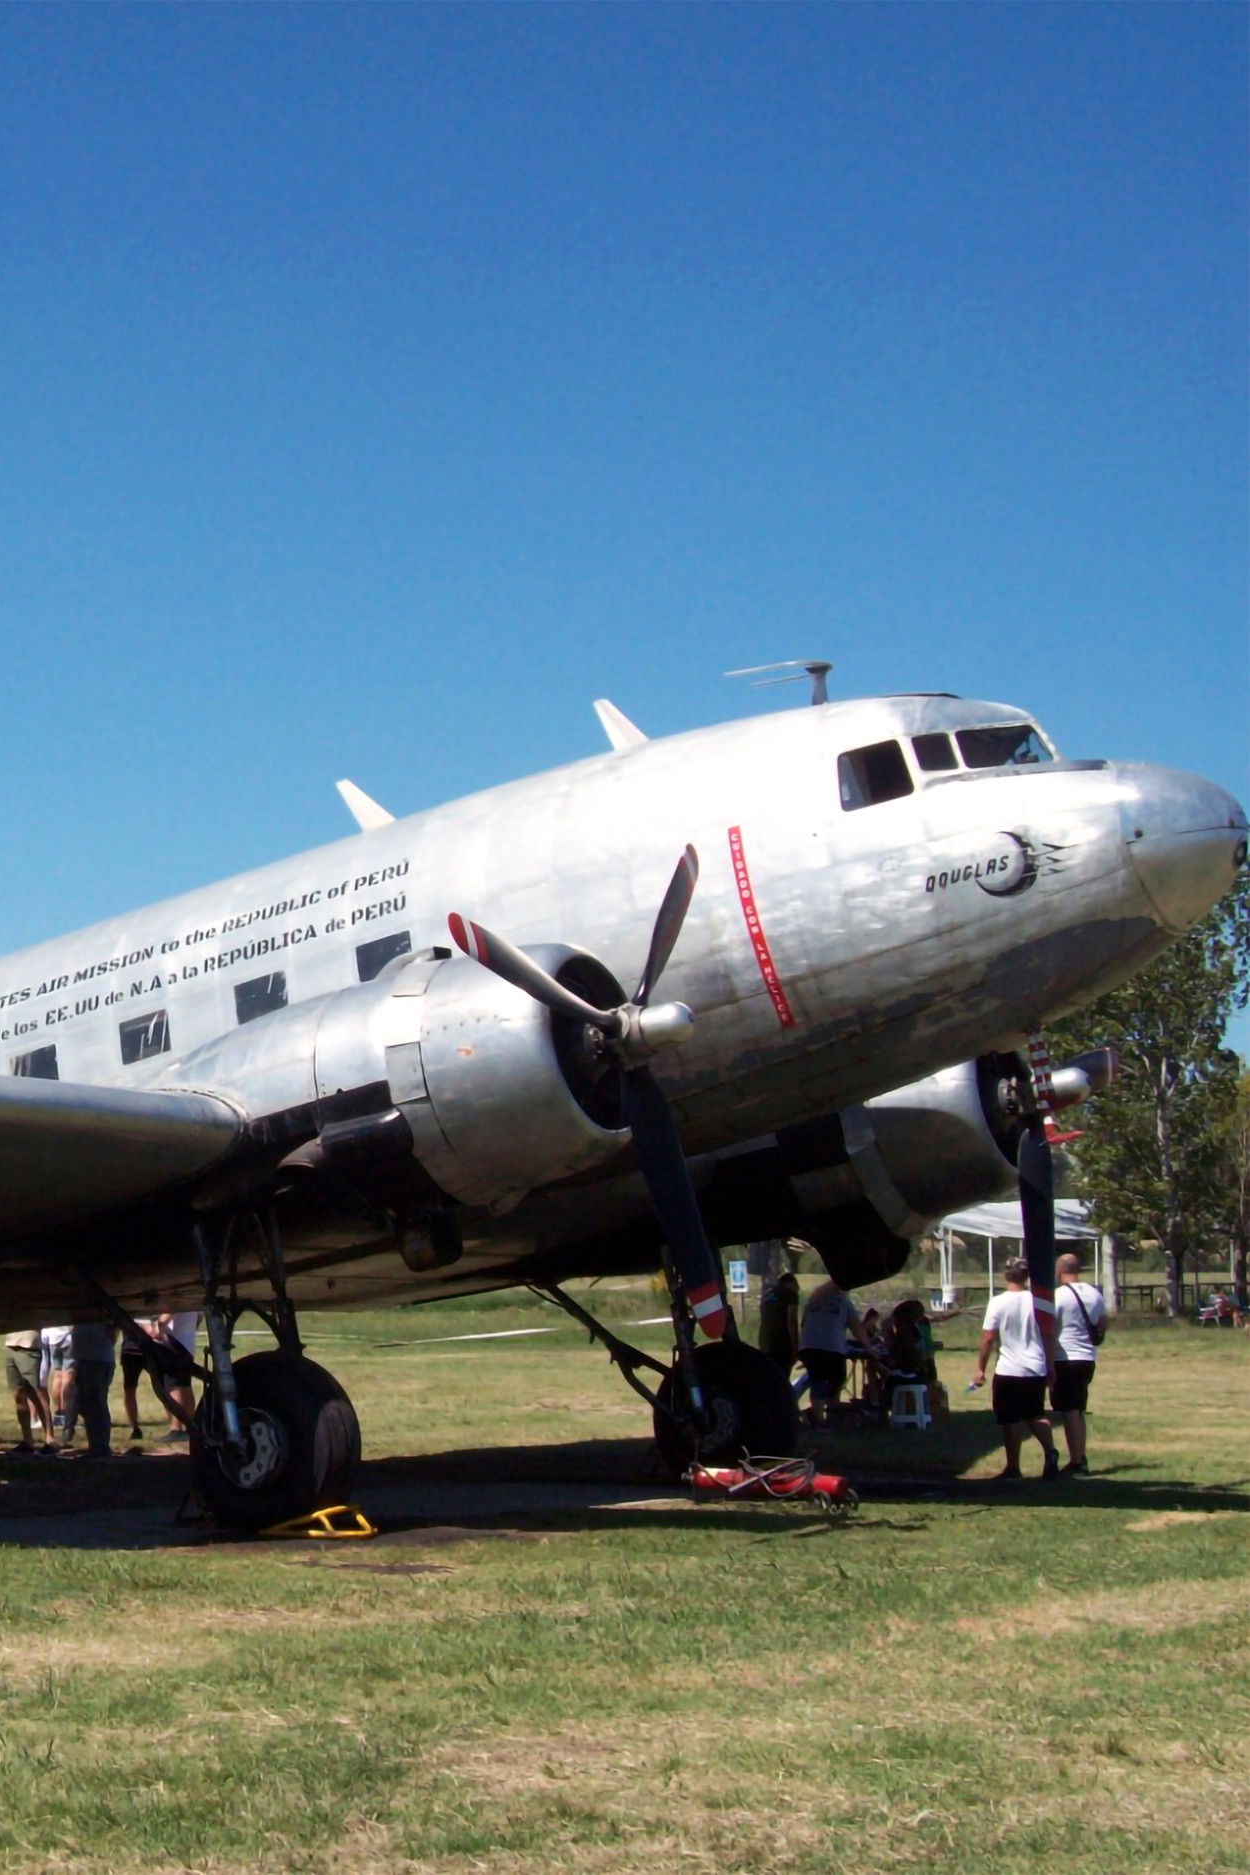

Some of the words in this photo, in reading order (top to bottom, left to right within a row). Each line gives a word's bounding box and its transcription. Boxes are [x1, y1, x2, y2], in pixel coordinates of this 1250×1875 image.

[36, 974, 70, 997] AIR
[73, 945, 154, 984] MISSION
[160, 939, 180, 955] to
[185, 927, 217, 946] the
[221, 889, 322, 935] REPUBLIC
[327, 880, 350, 900] of
[354, 858, 410, 892] PERÚ
[925, 855, 1009, 893] DOUGLAS
[14, 1020, 39, 1037] los
[45, 995, 100, 1026] EE.UU
[104, 991, 125, 1006] de
[130, 974, 163, 998] N.A
[167, 973, 178, 986] a
[182, 965, 199, 980] la
[204, 924, 318, 973] REPÚBLICA
[325, 916, 346, 934] de
[351, 891, 407, 926] PERÚ
